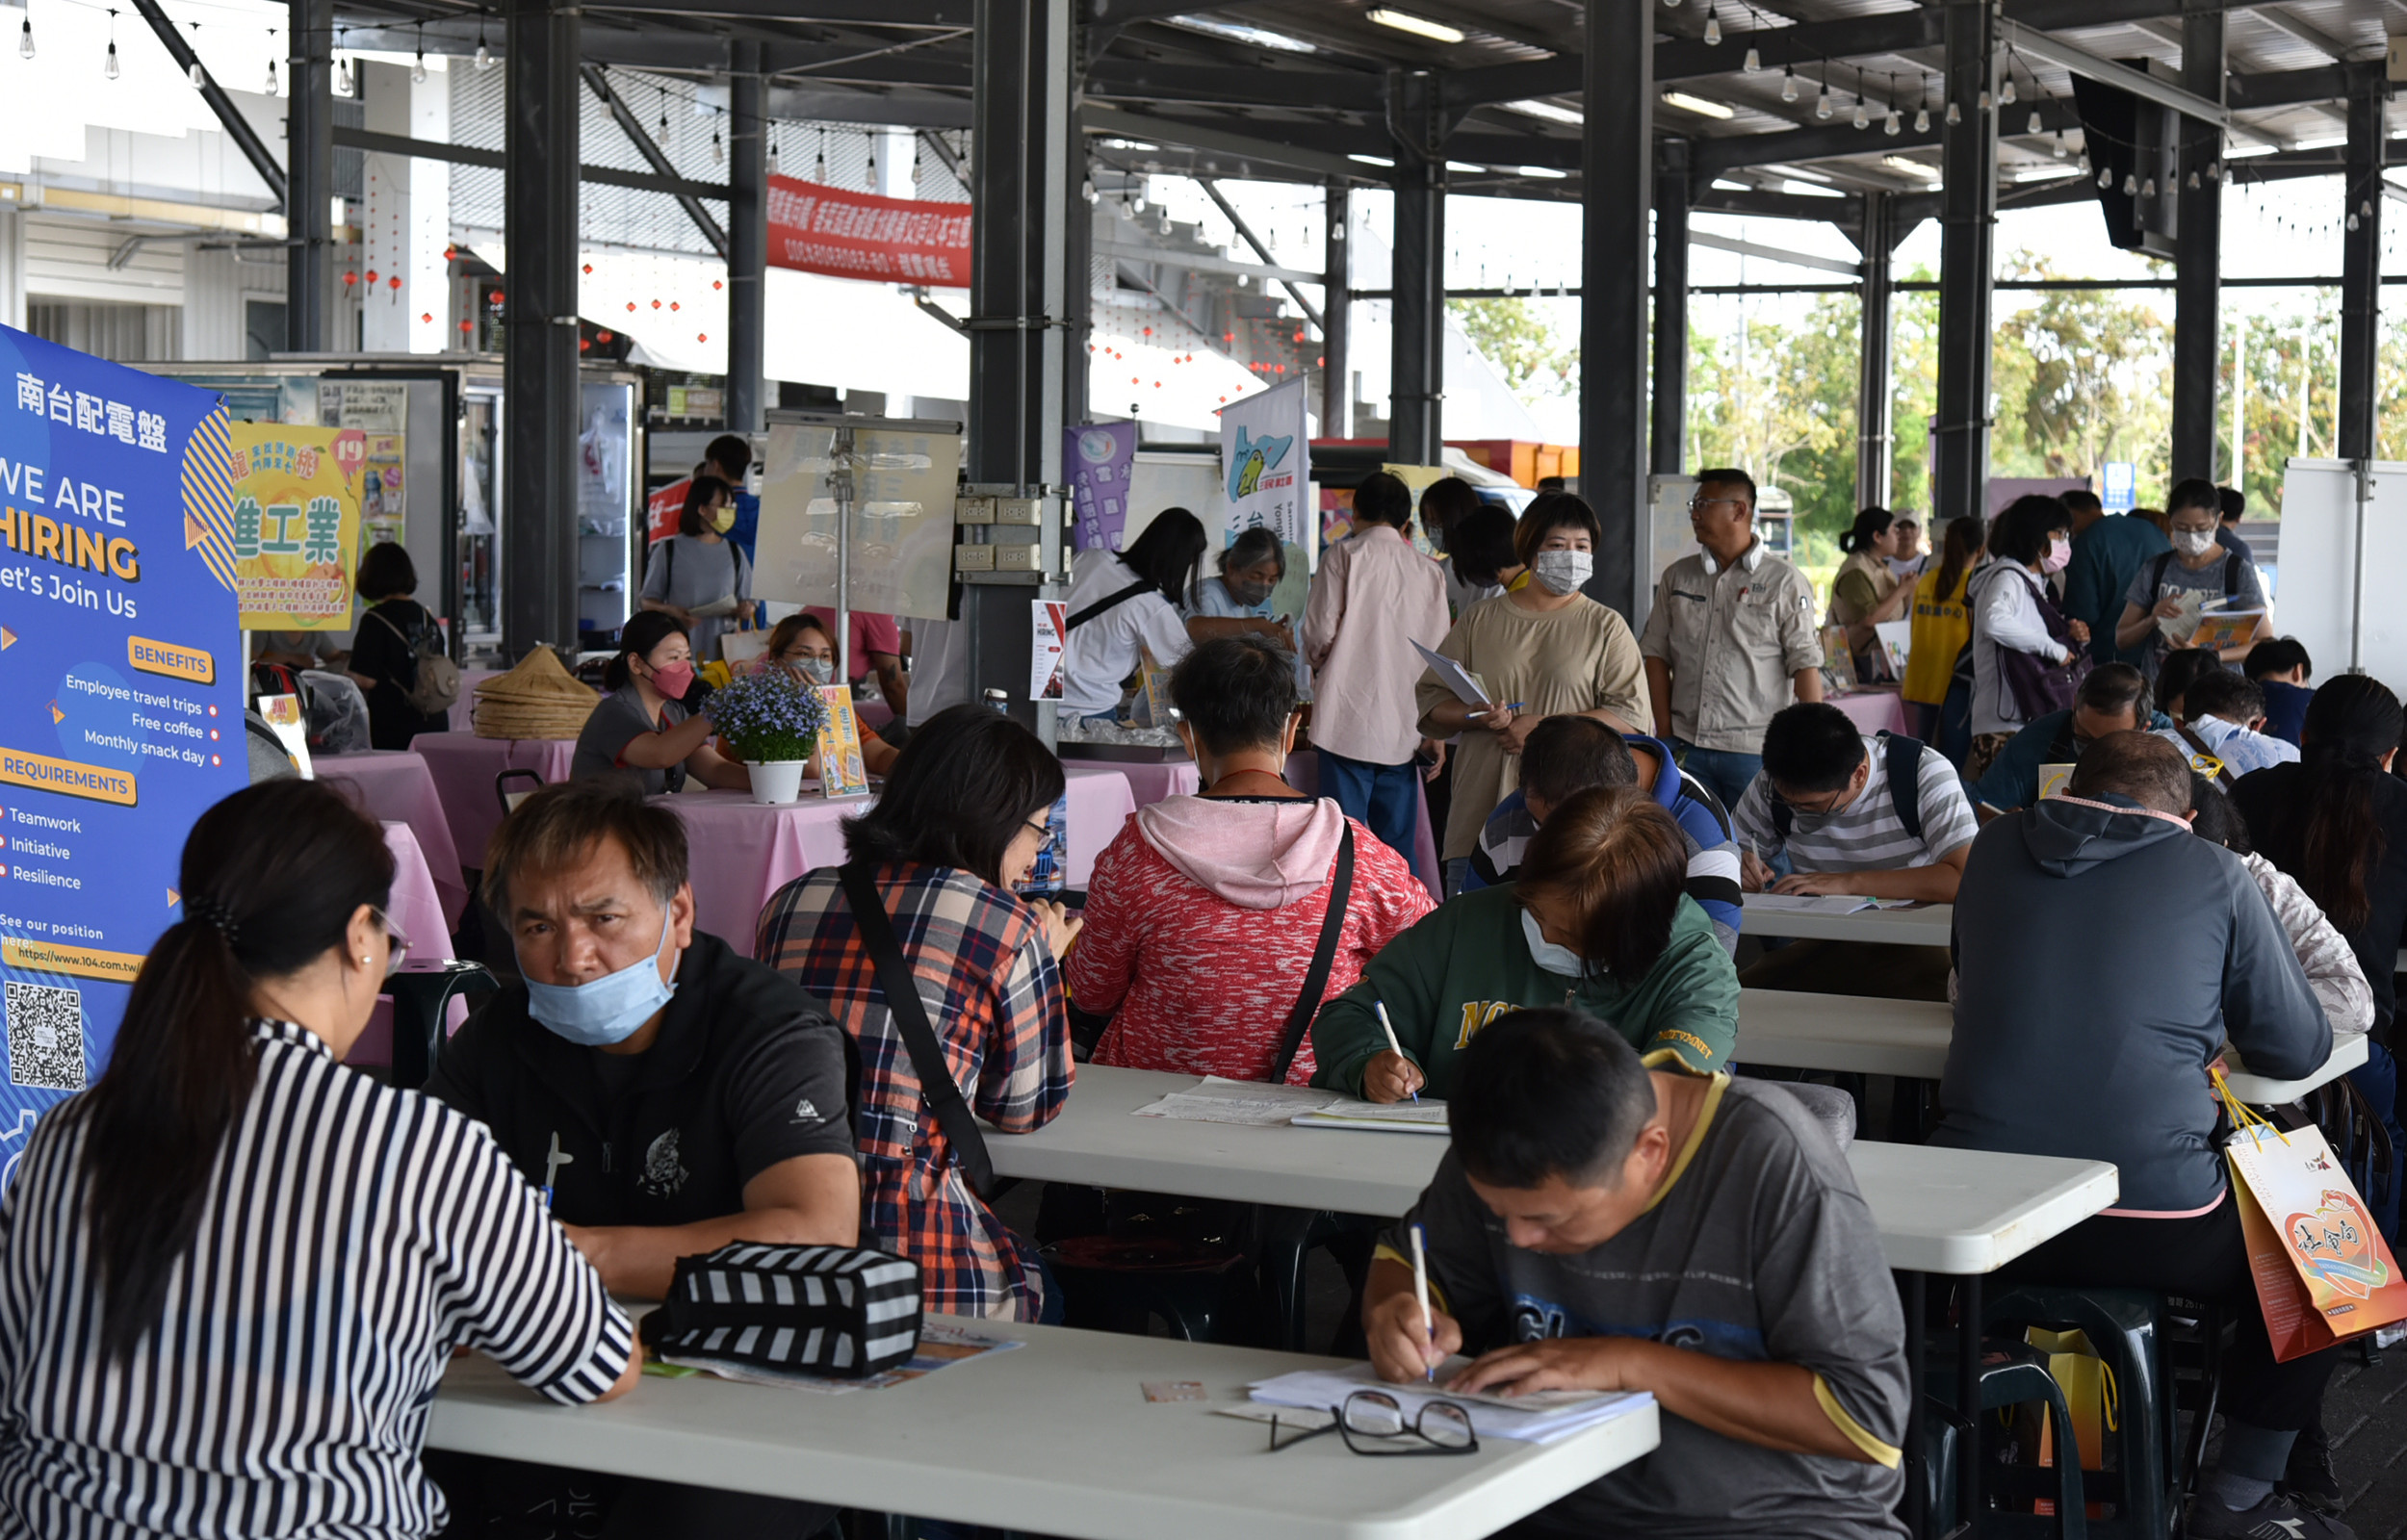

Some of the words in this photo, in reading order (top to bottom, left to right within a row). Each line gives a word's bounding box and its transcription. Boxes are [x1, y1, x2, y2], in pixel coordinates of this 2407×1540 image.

[16, 372, 168, 453] 南台配電盤
[337, 439, 364, 462] 19
[55, 476, 126, 527] ARE
[1274, 502, 1286, 539] Yongk
[0, 566, 43, 596] et's
[49, 575, 99, 610] Join
[106, 588, 138, 619] Us
[134, 645, 207, 674] BENEFITS
[65, 674, 131, 701] Employee
[133, 689, 171, 708] travel
[172, 698, 202, 716] trips
[132, 712, 162, 732] Free
[164, 721, 204, 739] coffee
[85, 729, 139, 756] Monthly
[141, 740, 180, 760] snack
[182, 747, 206, 768] day
[4, 757, 128, 795] REQUIREMENTS
[9, 808, 82, 834] Teamwork
[11, 836, 71, 860] Initiative
[13, 865, 82, 890] Resilience
[0, 913, 22, 928] See
[26, 919, 48, 932] our
[52, 924, 104, 940] position
[0, 933, 34, 949] here:
